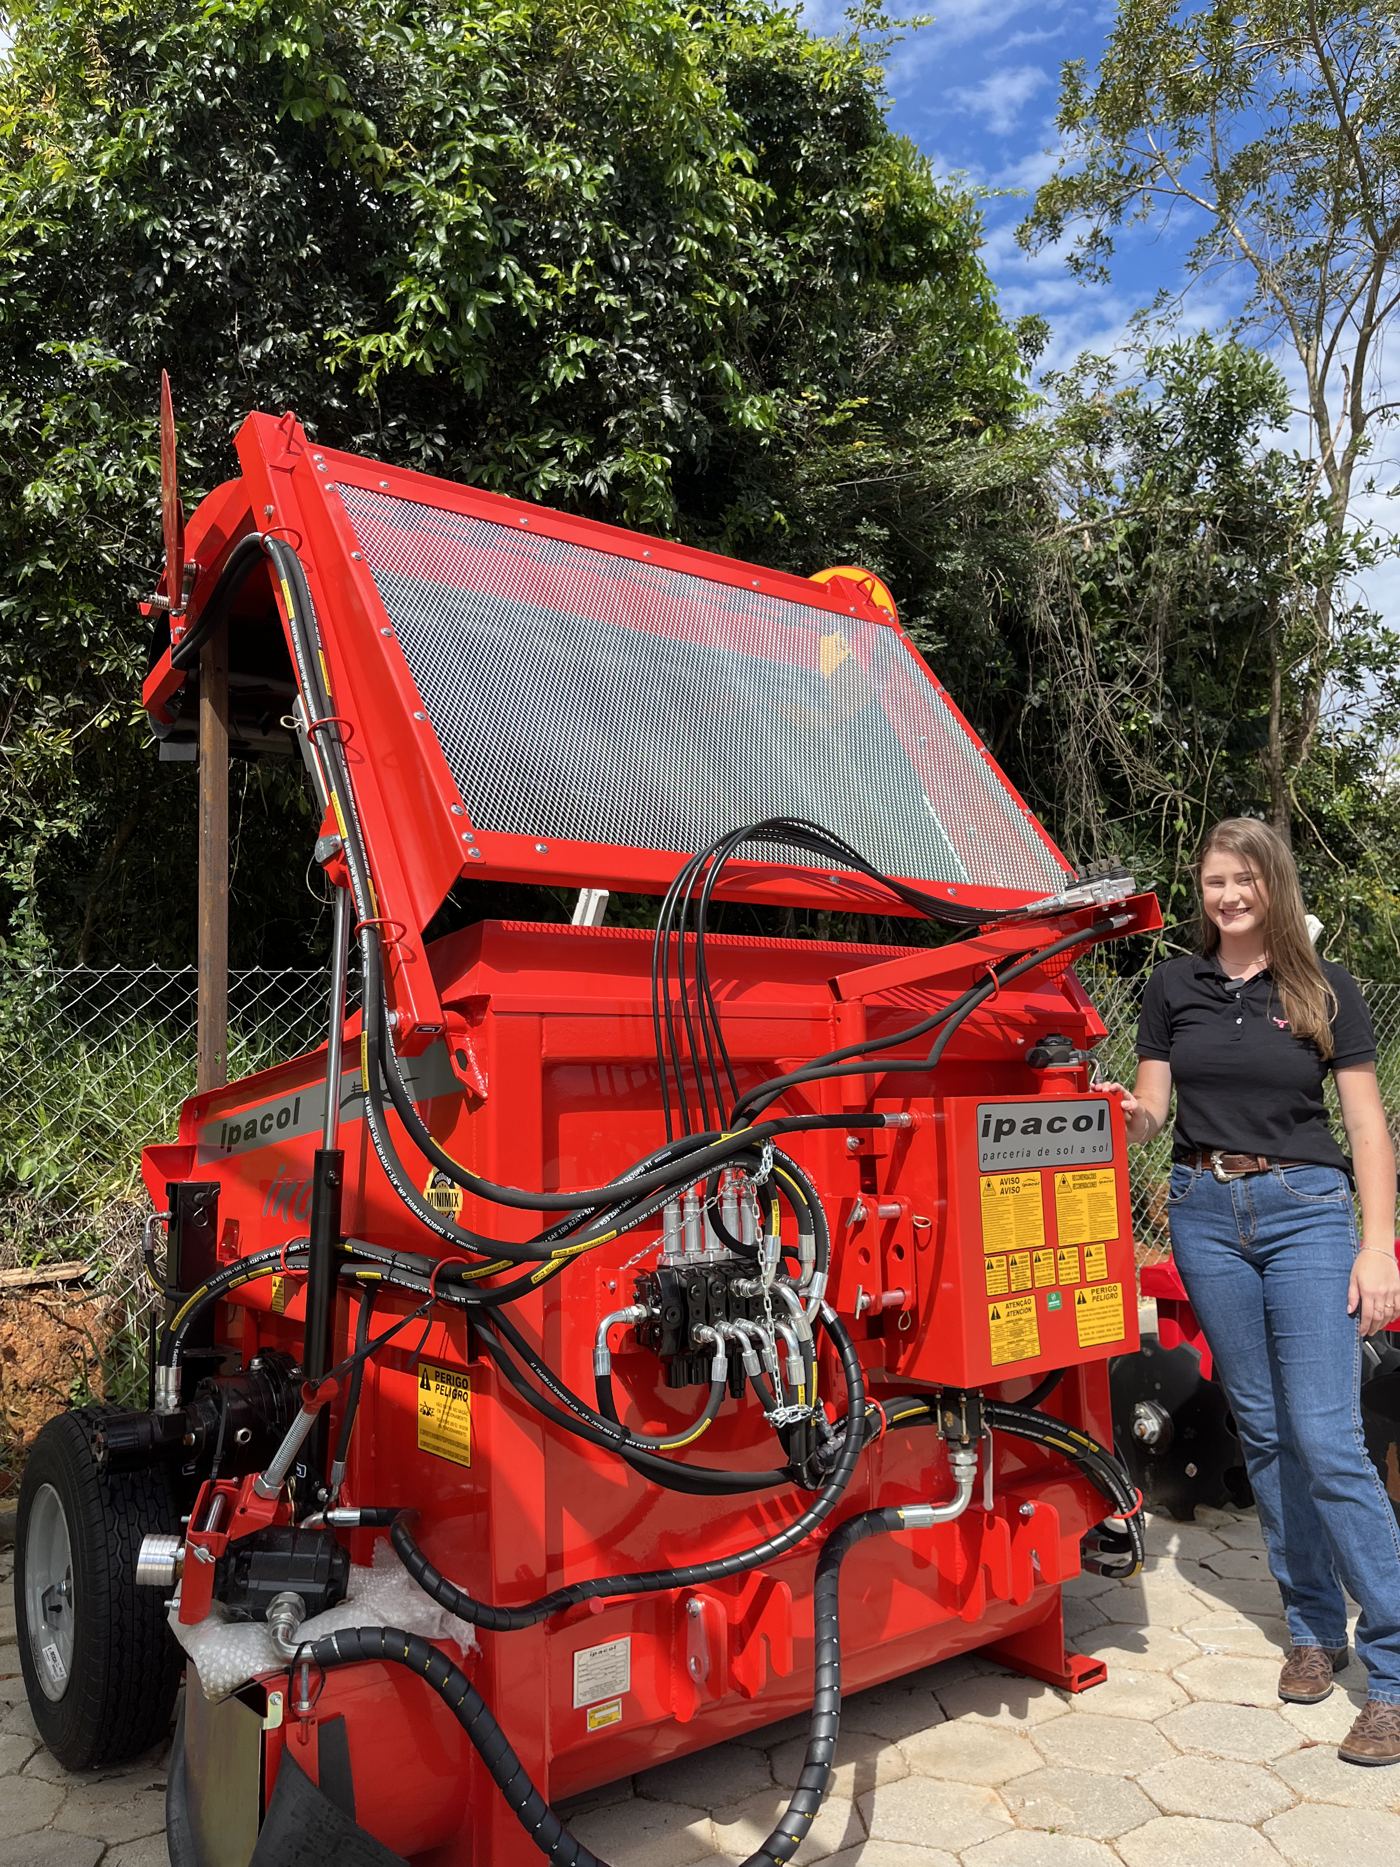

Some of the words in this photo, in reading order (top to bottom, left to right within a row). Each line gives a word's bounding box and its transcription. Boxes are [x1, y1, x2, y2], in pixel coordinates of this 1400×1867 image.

[220, 1096, 301, 1153] ipacol
[982, 1109, 1105, 1143] ipacol
[982, 1148, 1031, 1163] parceria
[1038, 1146, 1050, 1157] de
[1056, 1145, 1074, 1155] sol
[1092, 1143, 1109, 1153] sol
[1000, 1177, 1020, 1186] AVISO
[1000, 1186, 1021, 1195] AVISO
[380, 1155, 391, 1171] R2AT
[398, 1186, 407, 1197] WP
[446, 1232, 455, 1240] TT
[427, 1192, 459, 1207] MINIMIX
[650, 1207, 659, 1215] SAE
[659, 1200, 667, 1208] 100
[547, 1232, 559, 1242] SAE
[559, 1224, 569, 1234] 100
[569, 1214, 582, 1228] R2AT
[1090, 1285, 1118, 1295] PERIGO
[1091, 1292, 1119, 1303] PELIGRO
[434, 1370, 469, 1389] PERIGO
[435, 1384, 469, 1402] PELIGRO
